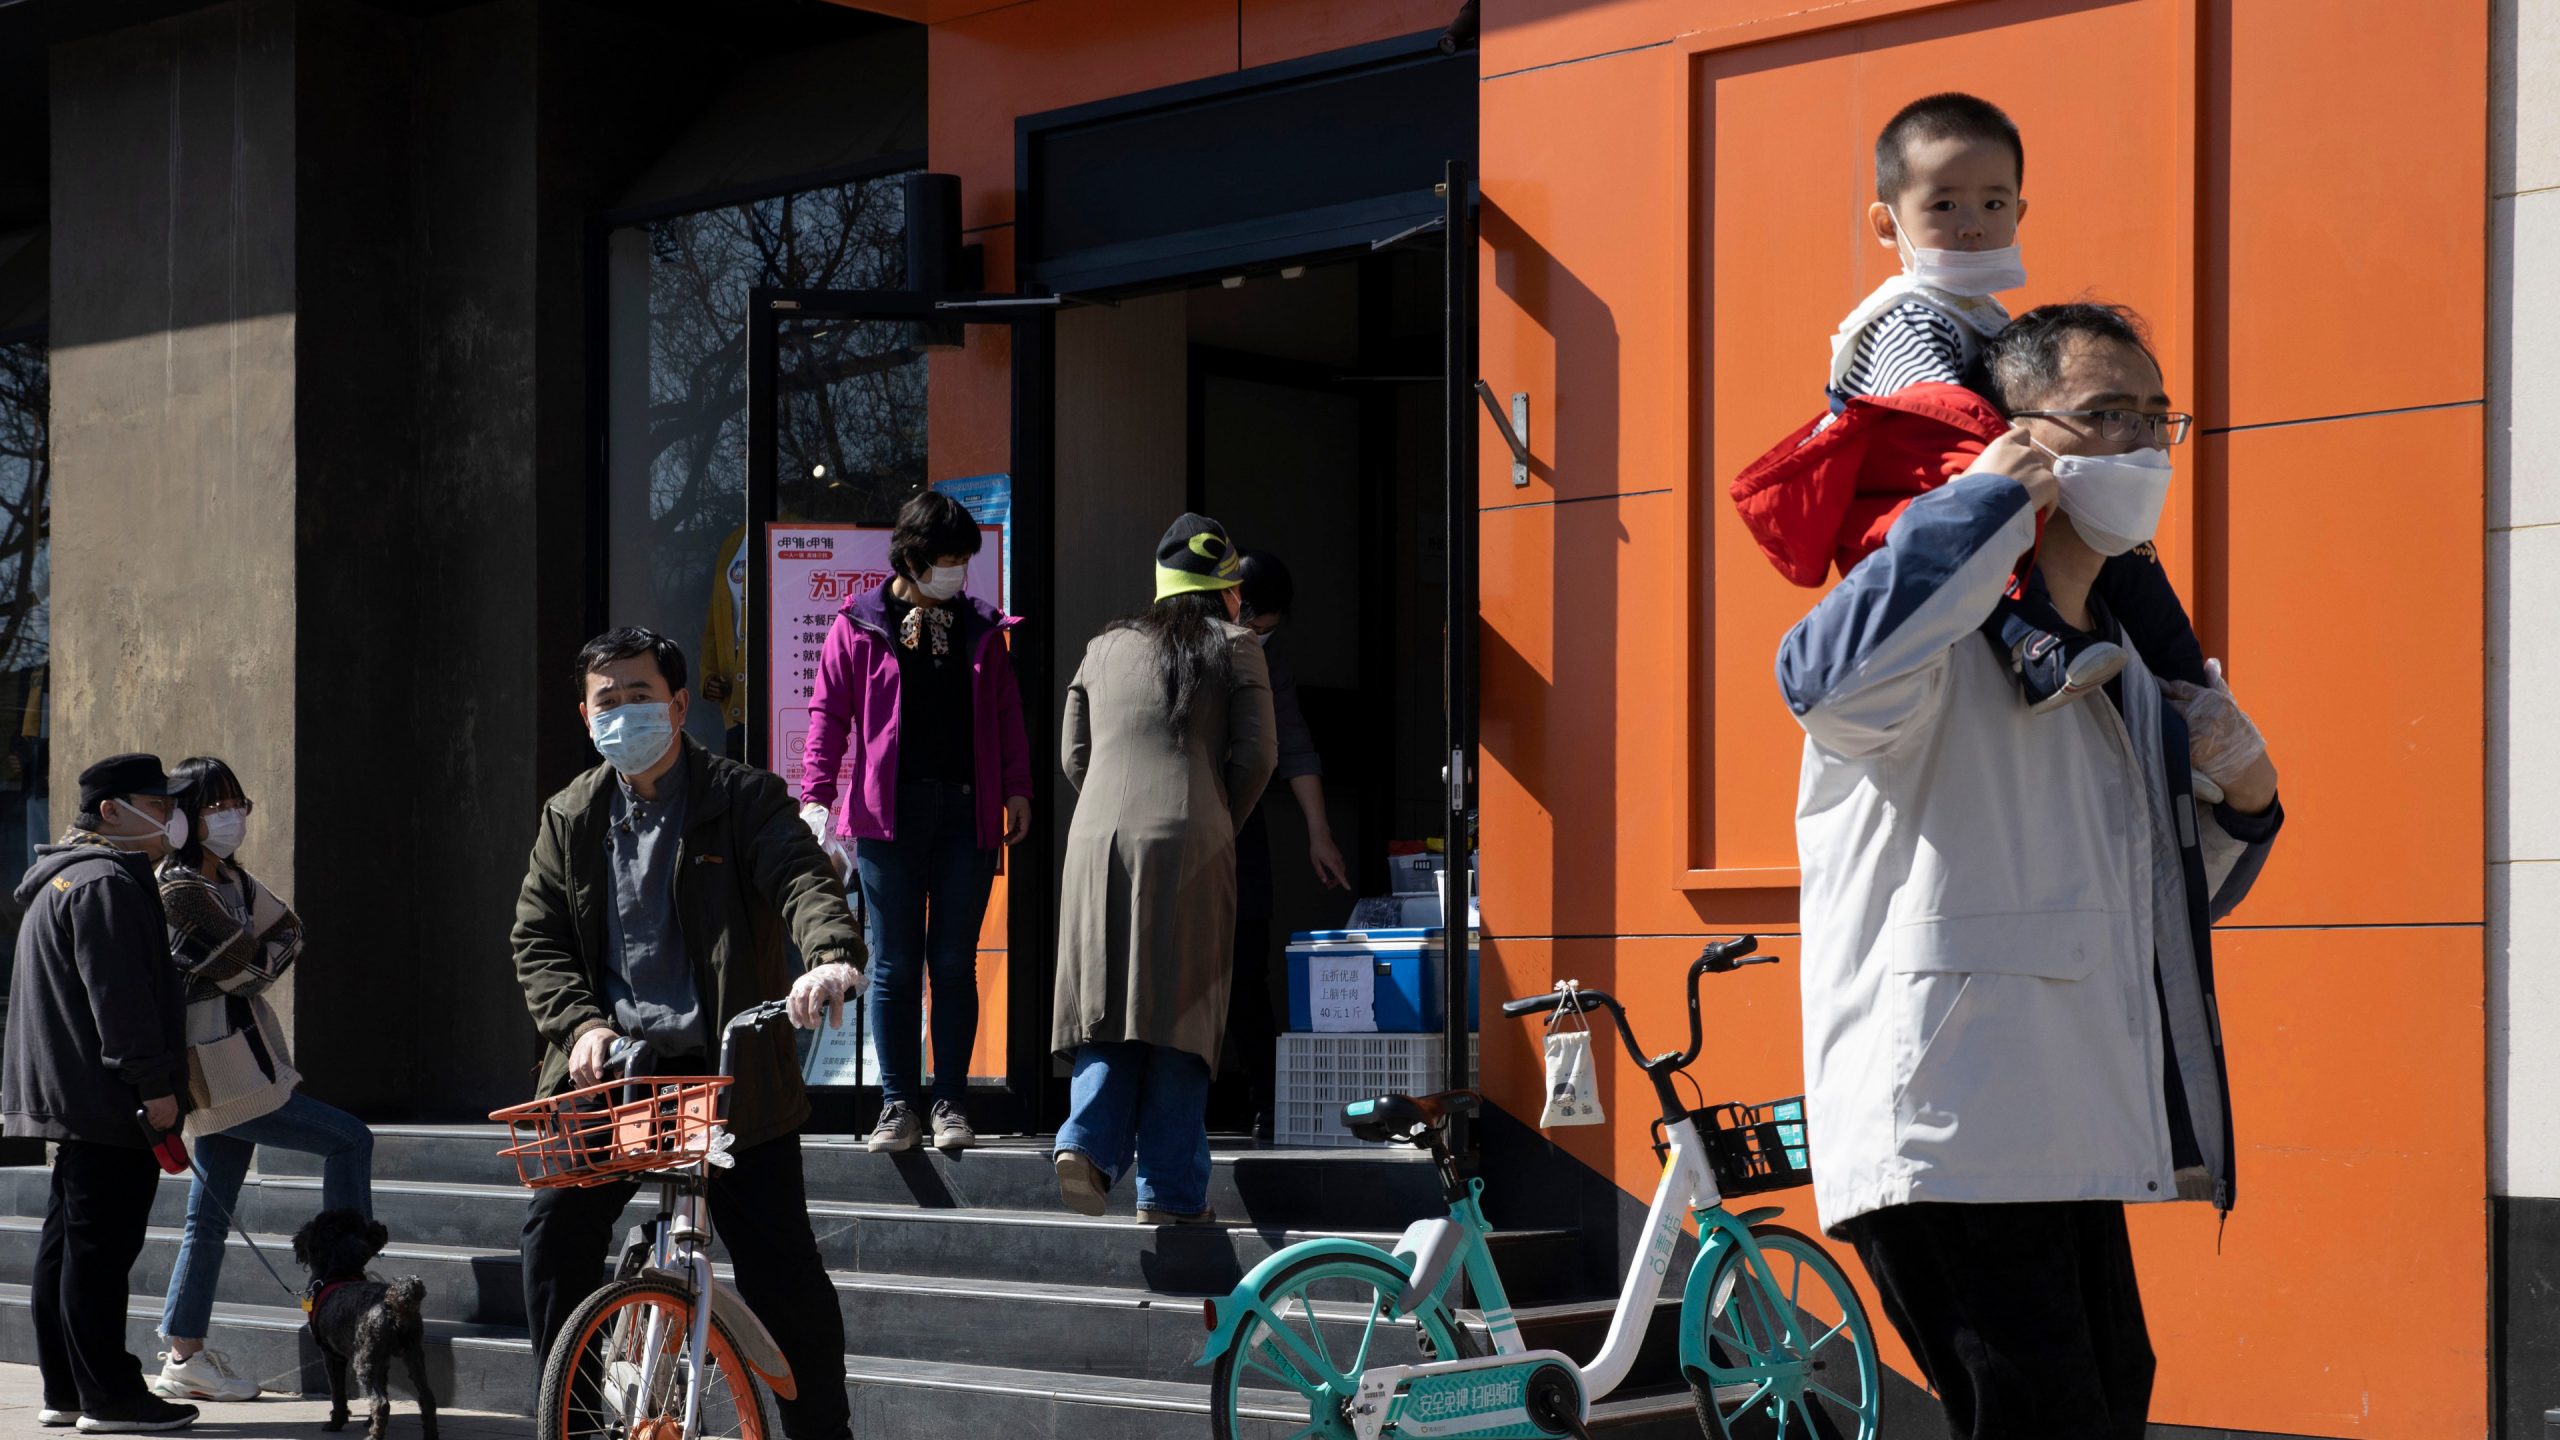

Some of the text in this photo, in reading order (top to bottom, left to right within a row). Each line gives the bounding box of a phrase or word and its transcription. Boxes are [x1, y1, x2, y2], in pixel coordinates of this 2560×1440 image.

[802, 632, 829, 644] 就餐
[803, 668, 819, 679] 推
[1320, 969, 1360, 982] 五折优惠
[1655, 1212, 1681, 1257] 青桔
[1420, 1380, 1520, 1417] 安全免押 扫码骑行
